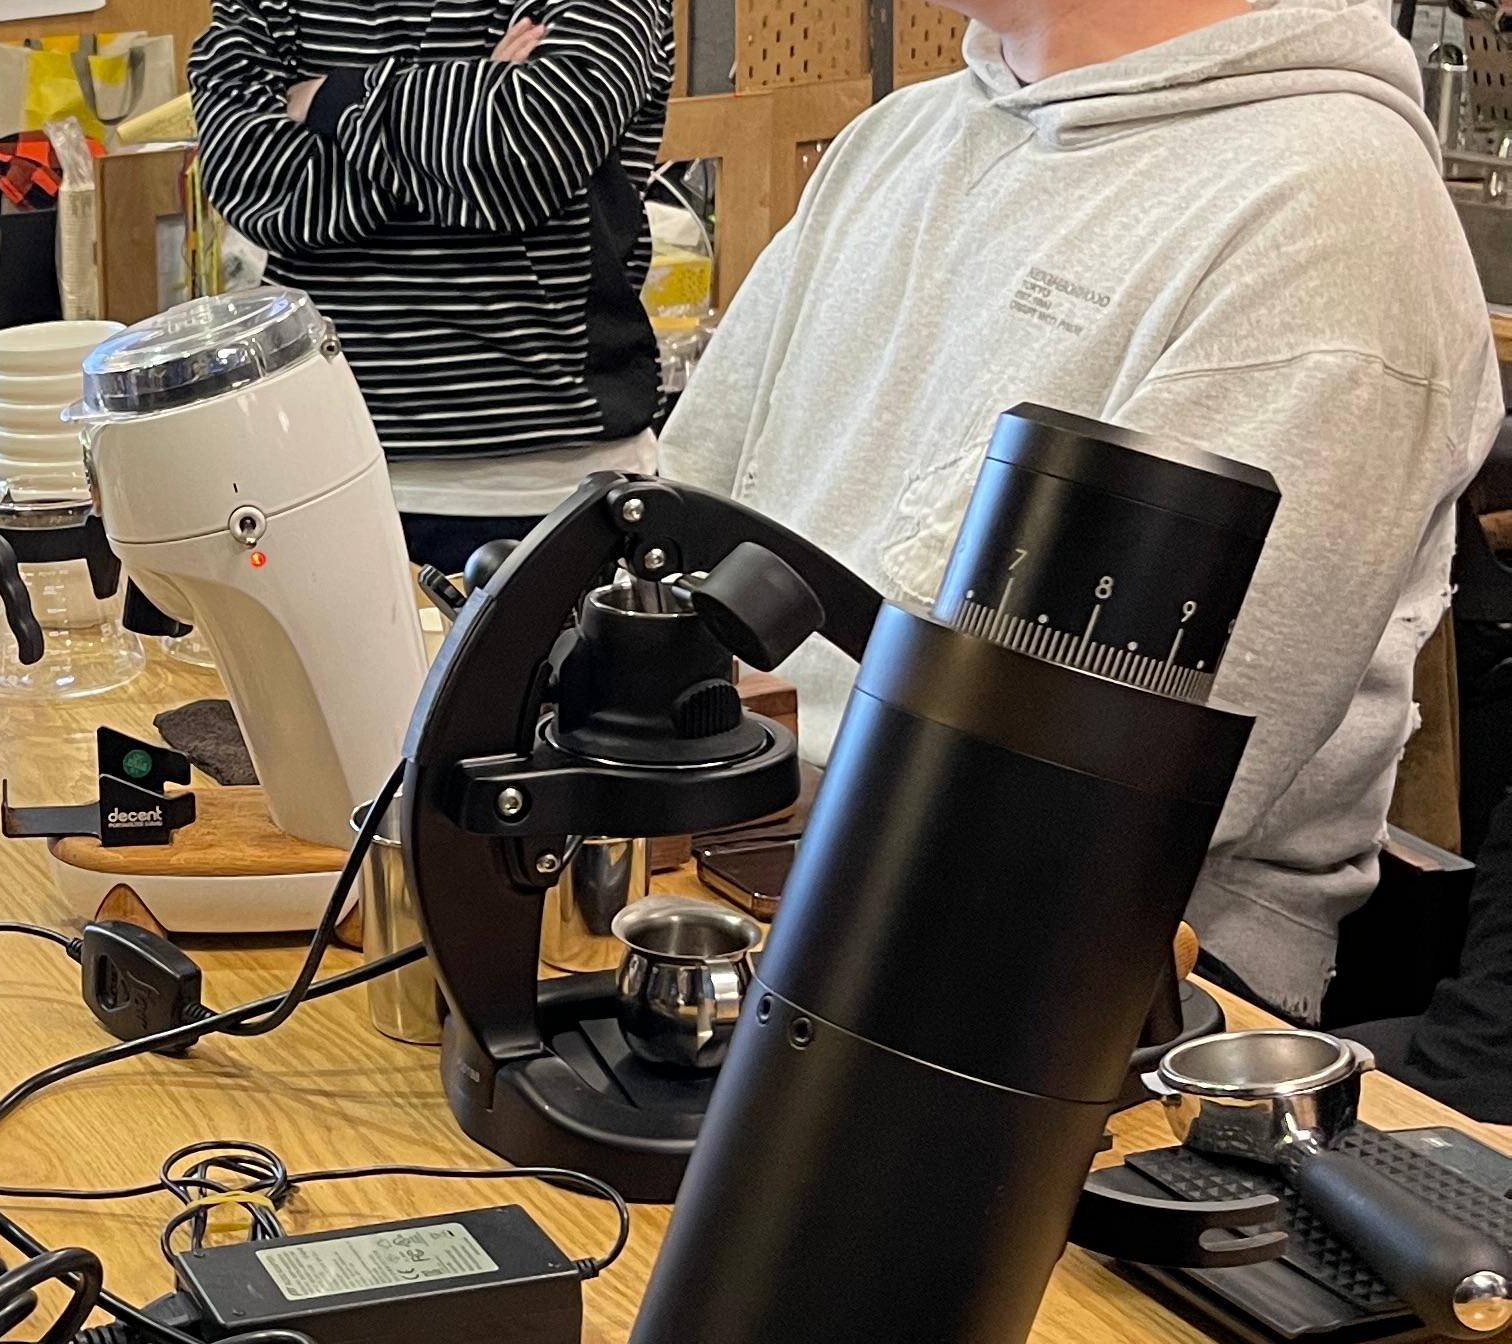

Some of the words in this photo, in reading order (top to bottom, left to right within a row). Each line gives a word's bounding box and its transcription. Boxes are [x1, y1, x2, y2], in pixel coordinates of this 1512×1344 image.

[1008, 548, 1028, 571] 7
[1094, 575, 1115, 599] 8
[1180, 600, 1198, 623] 9
[107, 804, 163, 823] decent
